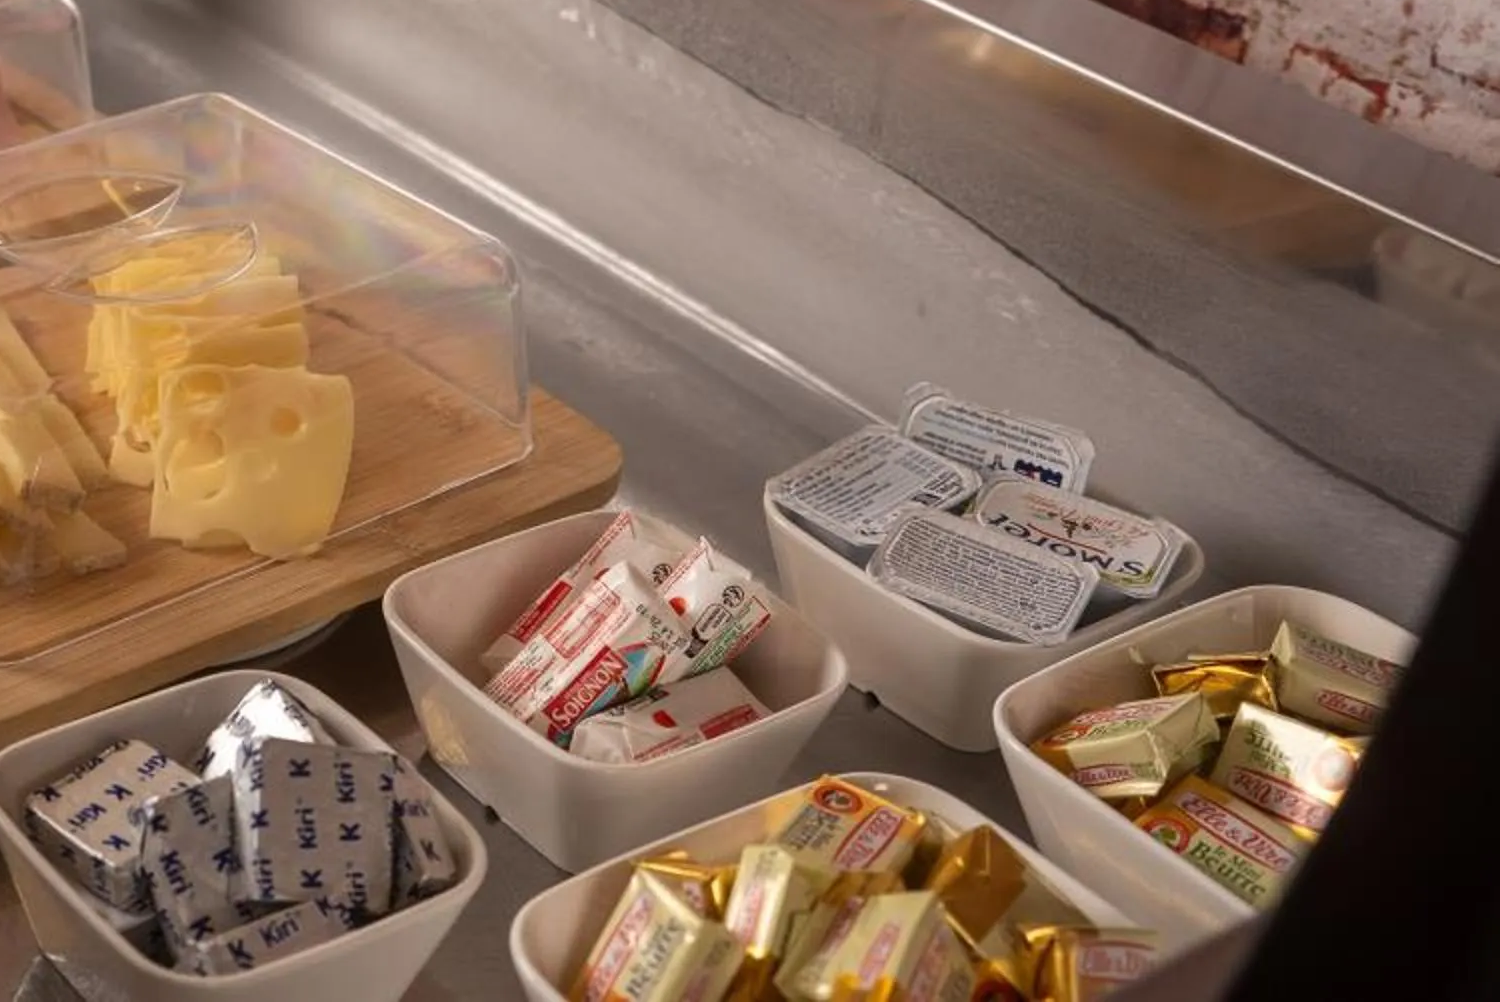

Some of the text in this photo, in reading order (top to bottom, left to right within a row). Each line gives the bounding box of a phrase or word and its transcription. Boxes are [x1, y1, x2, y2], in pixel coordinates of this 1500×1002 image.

[550, 649, 623, 730] SOIGNON
[289, 758, 311, 778] K
[104, 783, 134, 802] K
[334, 761, 355, 804] Kiri
[68, 802, 108, 830] Kiri
[251, 809, 269, 829] K
[295, 807, 318, 849] Kiri
[102, 834, 131, 852] K
[339, 822, 362, 842] K
[159, 850, 194, 896] Kiri
[301, 869, 323, 888] K
[1190, 840, 1266, 896] Beurre
[189, 914, 215, 942] K
[259, 915, 300, 948] Kiri
